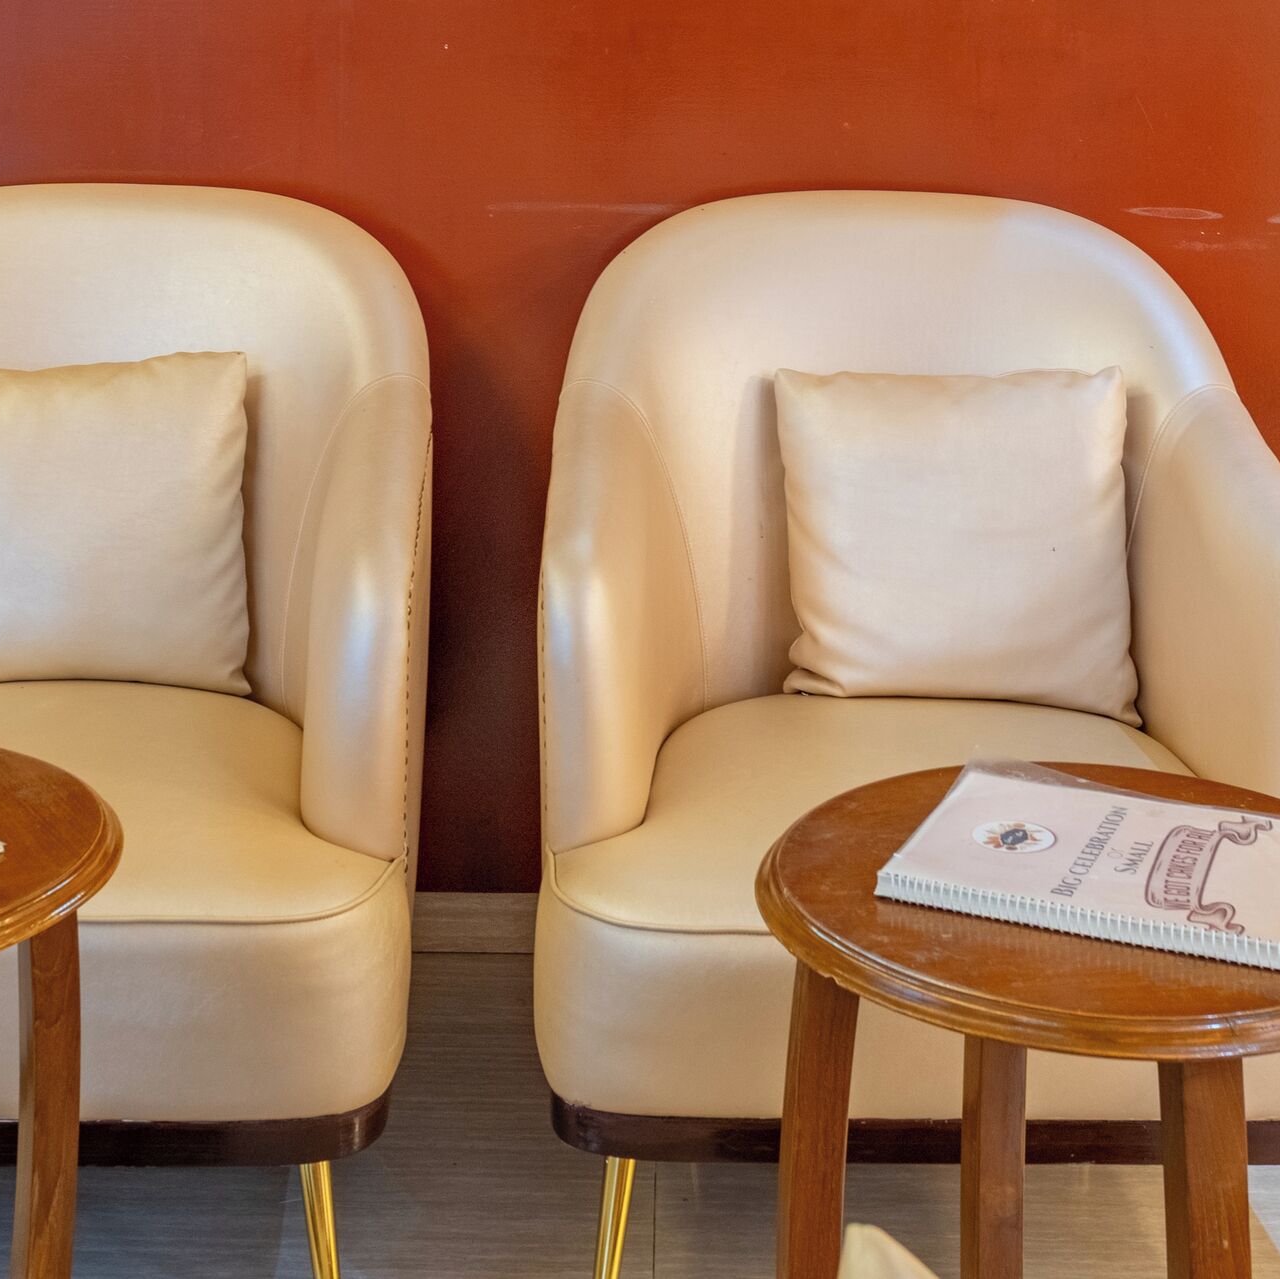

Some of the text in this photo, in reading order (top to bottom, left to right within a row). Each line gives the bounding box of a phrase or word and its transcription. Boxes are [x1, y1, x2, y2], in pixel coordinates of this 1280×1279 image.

[1050, 805, 1128, 898] BIG CELEBRATION
[1176, 839, 1208, 855] FOR
[1113, 841, 1154, 875] SMALL
[1166, 854, 1198, 879] CAKES
[1163, 879, 1191, 896] GOT
[1163, 897, 1191, 910] WE
